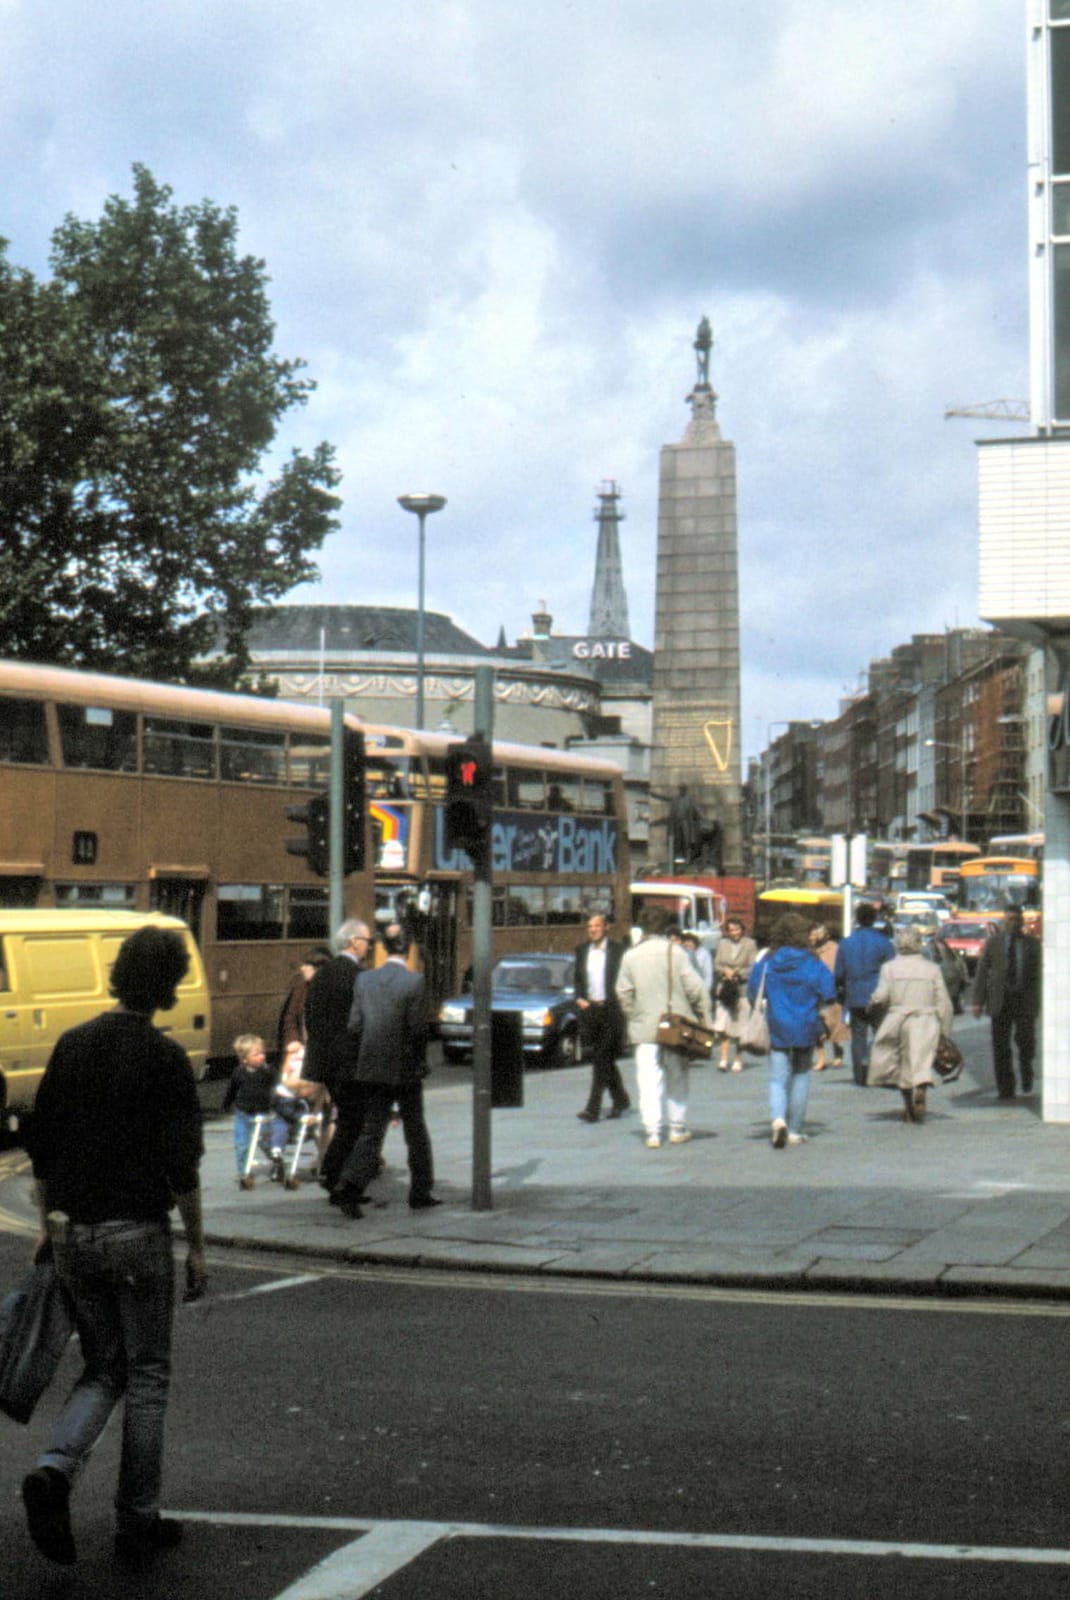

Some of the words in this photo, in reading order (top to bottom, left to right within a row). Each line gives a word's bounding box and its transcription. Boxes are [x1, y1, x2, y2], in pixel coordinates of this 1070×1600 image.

[573, 641, 631, 659] GATE
[435, 806, 518, 871] Uer
[558, 816, 616, 874] Bank
